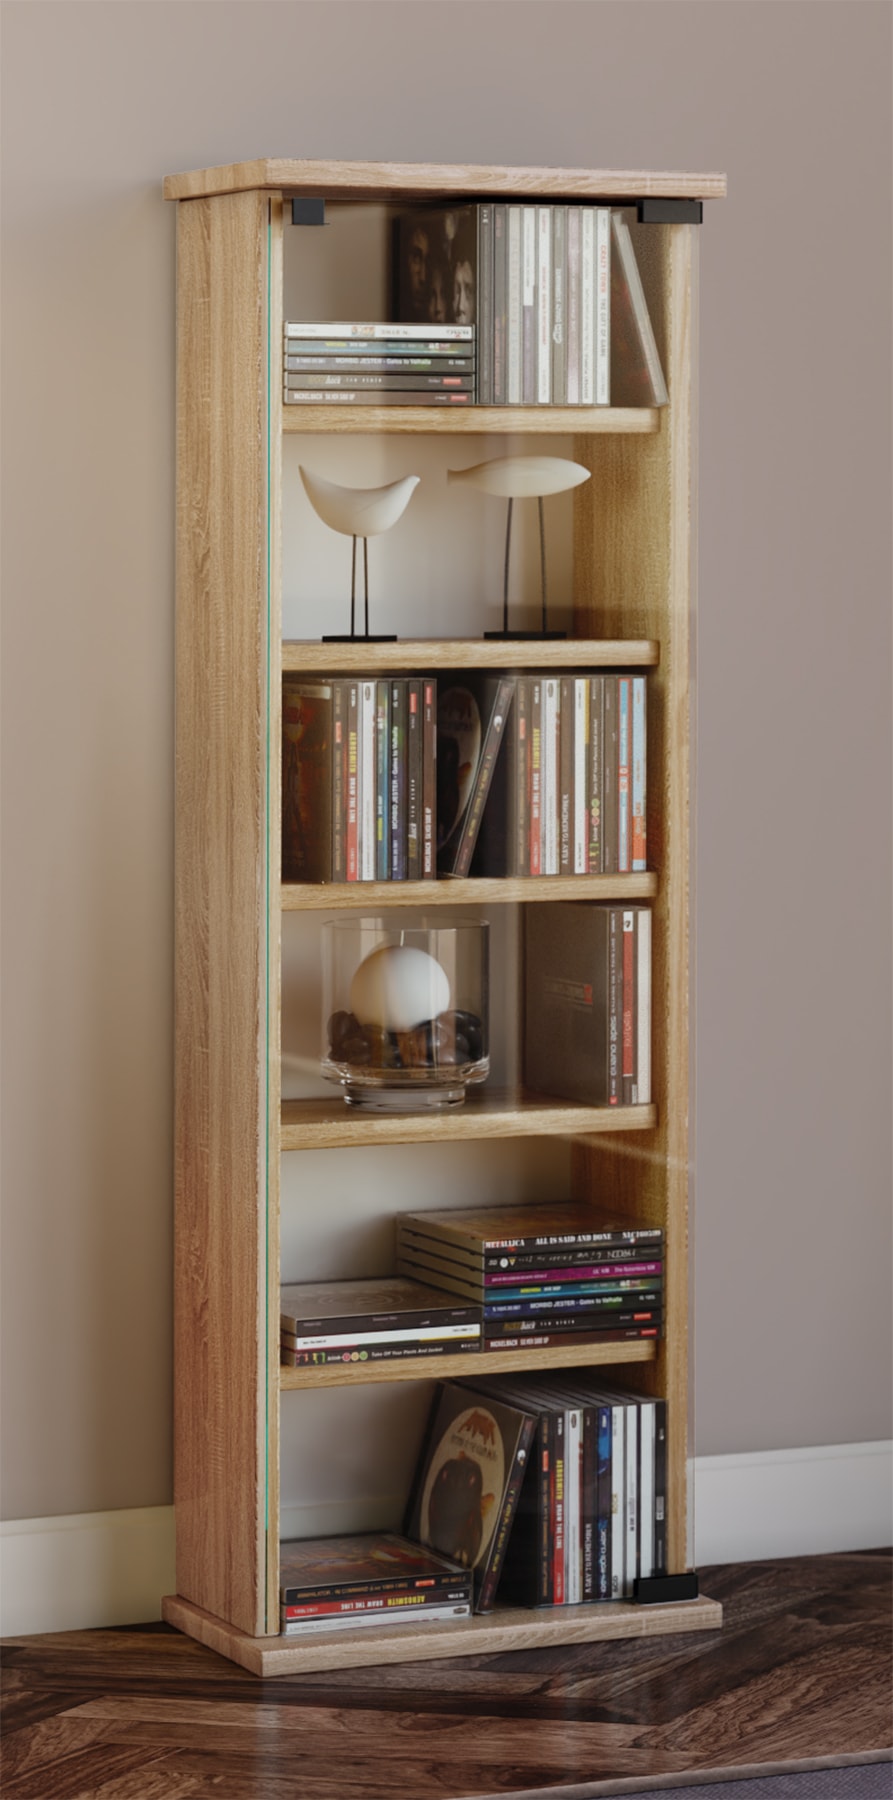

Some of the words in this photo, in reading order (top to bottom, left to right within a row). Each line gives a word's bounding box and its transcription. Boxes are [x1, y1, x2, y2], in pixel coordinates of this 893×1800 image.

[485, 1239, 525, 1248] METALLICA
[535, 1237, 548, 1245] ALL
[387, 1595, 425, 1606] AEROSMITH
